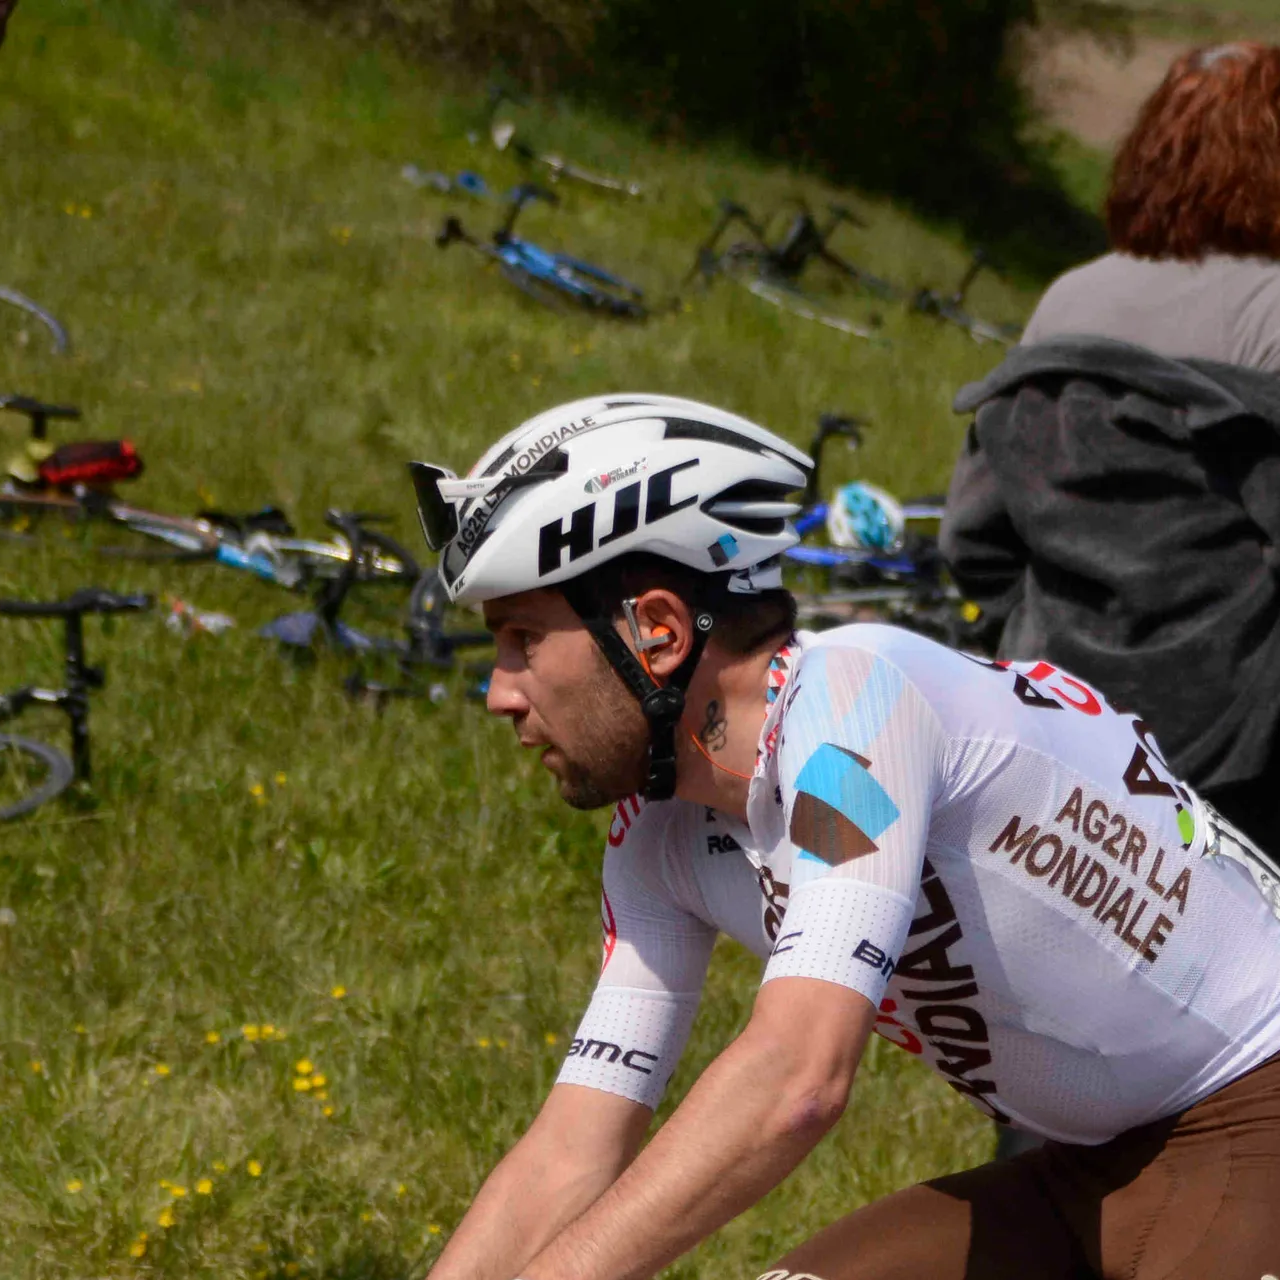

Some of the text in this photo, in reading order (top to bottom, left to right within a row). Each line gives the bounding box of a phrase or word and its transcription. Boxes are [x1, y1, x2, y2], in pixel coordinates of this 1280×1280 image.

[456, 506, 489, 557] AG2R
[503, 416, 596, 479] MONDIALE
[538, 457, 700, 578] HJC
[988, 815, 1175, 964] MONDIALE
[1054, 786, 1148, 876] AG2R
[1145, 848, 1193, 916] LA
